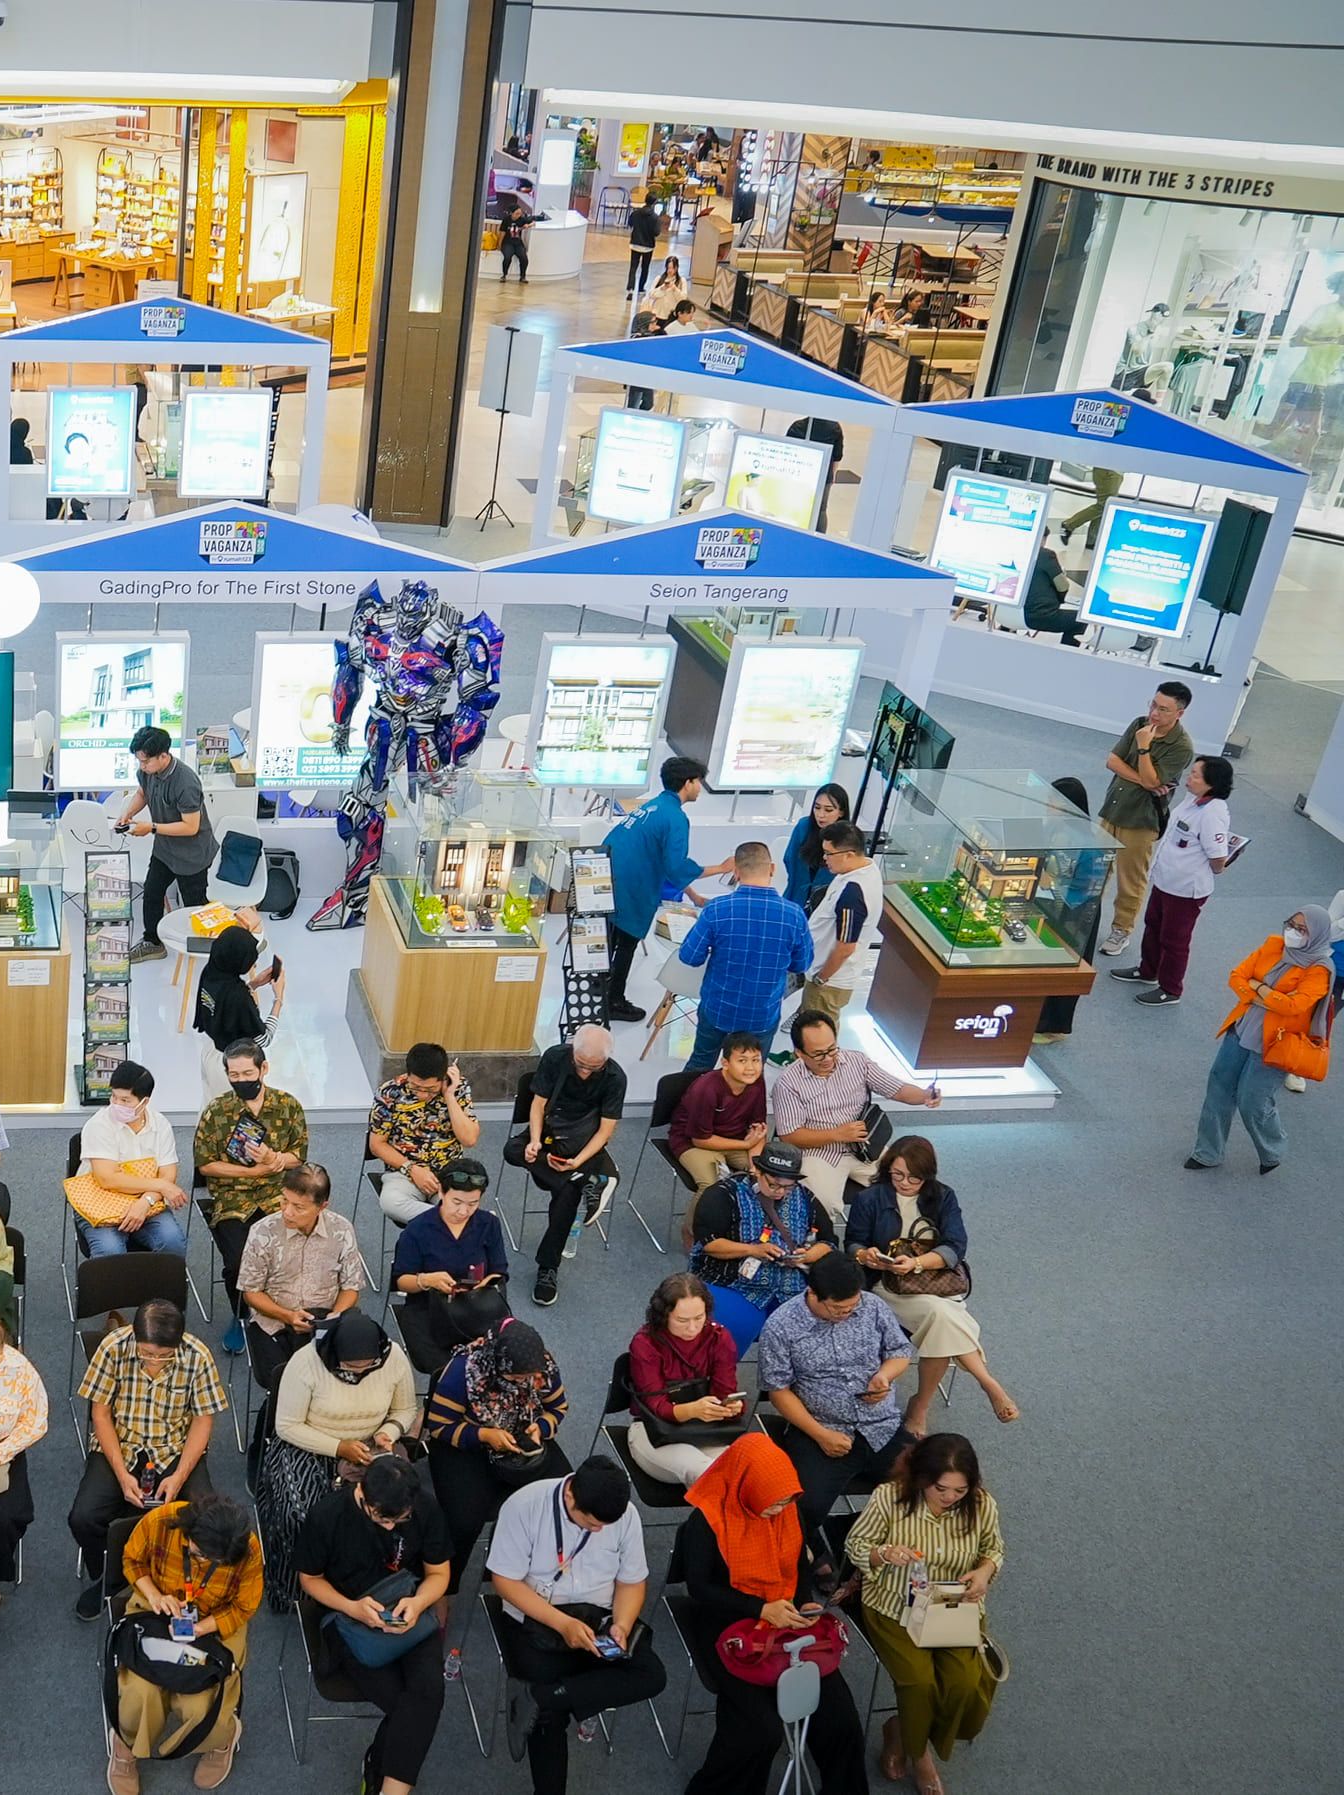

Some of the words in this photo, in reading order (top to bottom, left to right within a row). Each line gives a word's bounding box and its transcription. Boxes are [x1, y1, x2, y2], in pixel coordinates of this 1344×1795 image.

[1036, 153, 1055, 170] THE
[1056, 158, 1097, 179] BRAND
[1102, 166, 1143, 185] WITH
[1148, 170, 1179, 189] THE
[1184, 174, 1196, 190] 3
[1200, 176, 1275, 198] STRIPES
[143, 308, 163, 317] PROP
[144, 320, 177, 328] VAGANZA
[704, 341, 724, 352] PROP
[703, 353, 736, 366] VAGANZA
[1077, 400, 1102, 413] PROP
[1075, 413, 1115, 428] VAGANZA
[203, 524, 233, 536] PROP
[702, 530, 730, 542] PROP
[204, 540, 253, 552] VAGANZA
[700, 546, 746, 558] VAGANZA
[99, 580, 192, 598] GadingPro
[197, 580, 220, 595] for
[225, 580, 257, 595] The
[264, 580, 301, 595] First
[306, 580, 356, 595] Stone
[650, 583, 697, 598] Seion
[704, 584, 788, 603] Tangerang
[68, 739, 106, 748] ORCHID
[303, 756, 322, 764] 0811
[954, 1015, 1000, 1030] seion
[768, 1156, 793, 1168] CELINE
